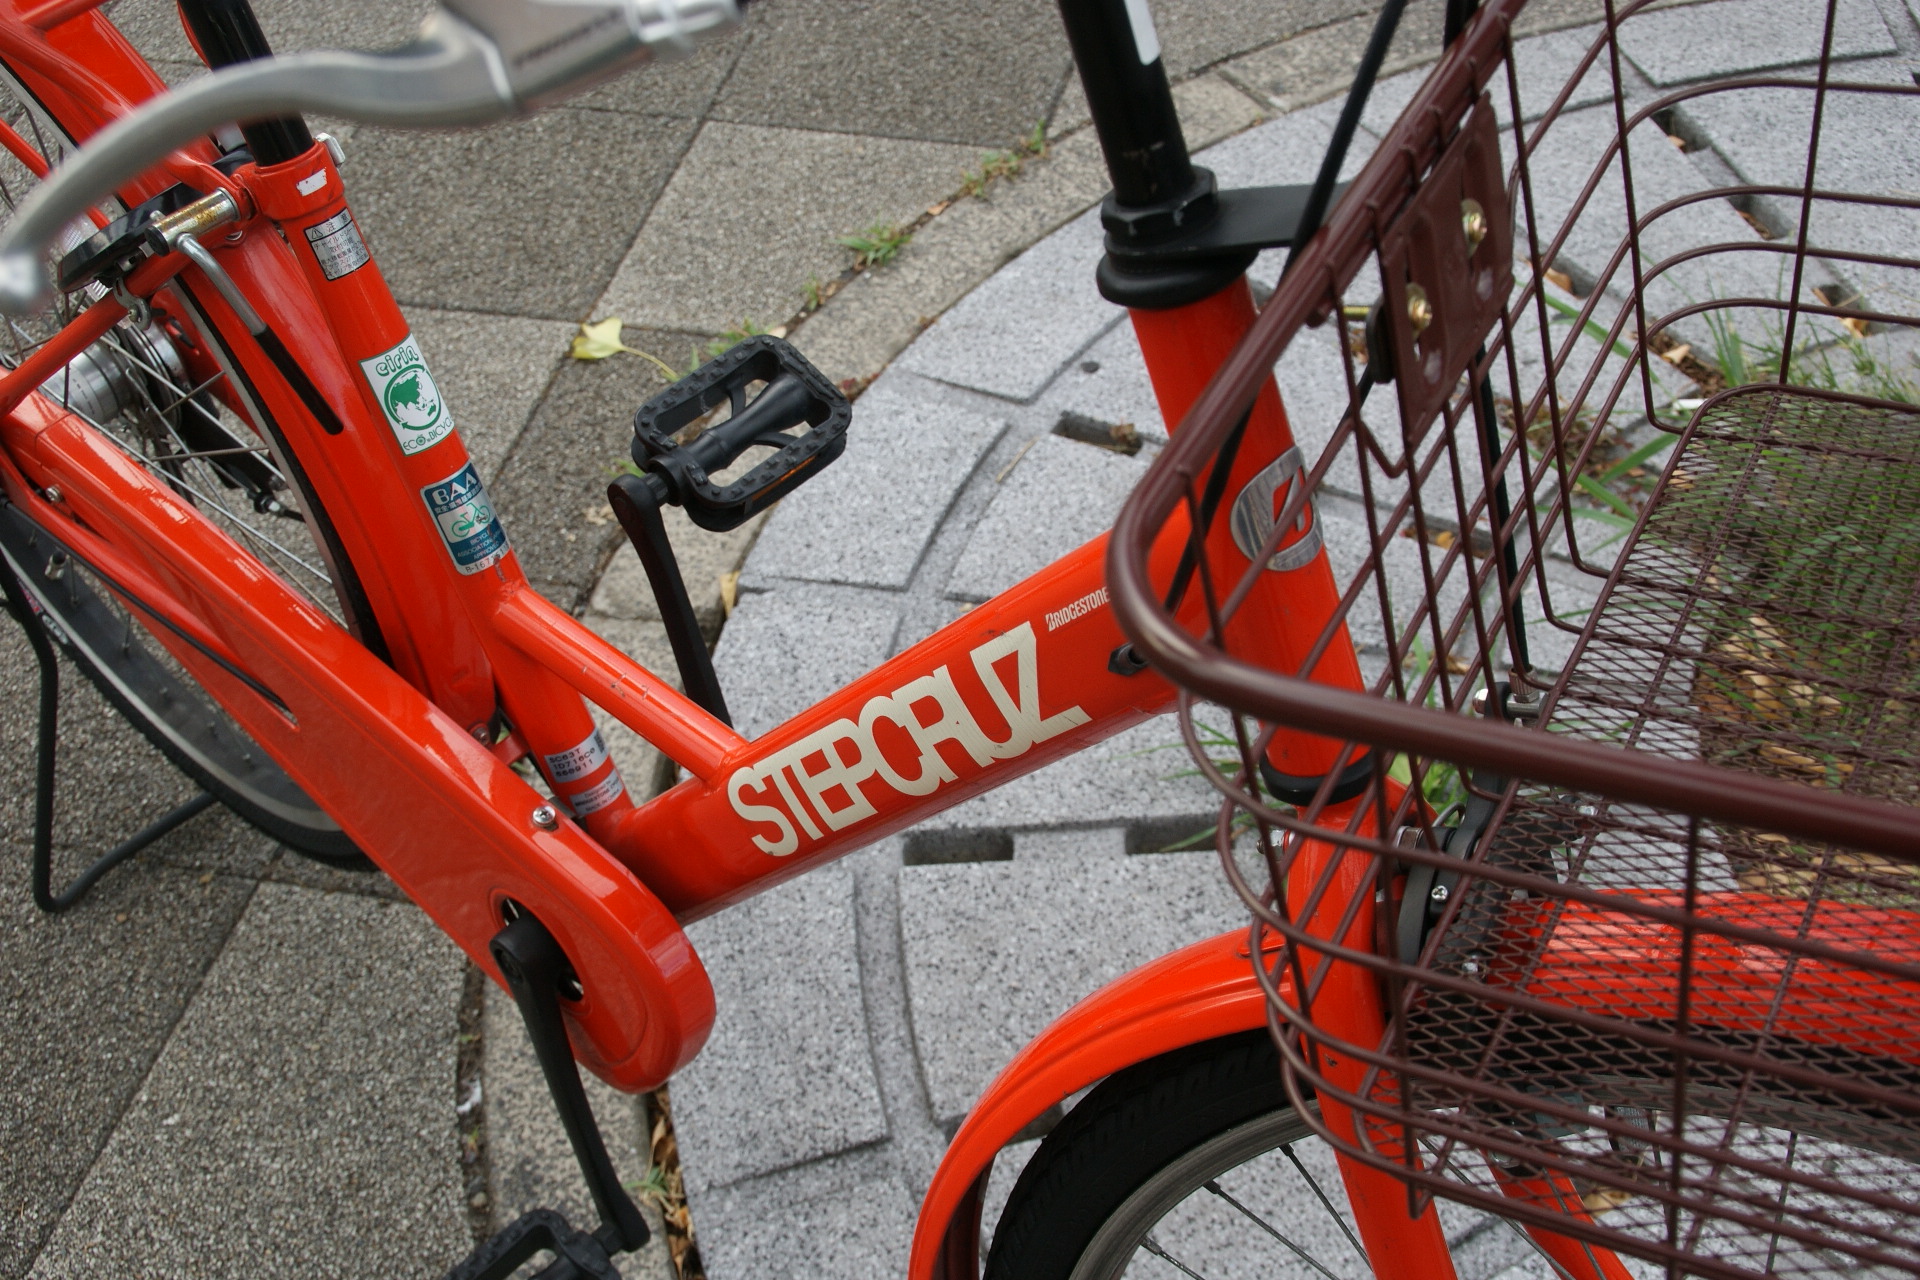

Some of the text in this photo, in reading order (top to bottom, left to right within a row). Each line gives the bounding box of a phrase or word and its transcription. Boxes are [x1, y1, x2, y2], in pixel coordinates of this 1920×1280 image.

[432, 472, 477, 505] BAA
[1045, 586, 1110, 632] BRIDGESTONE
[727, 621, 1093, 857] STEPCRUZ
